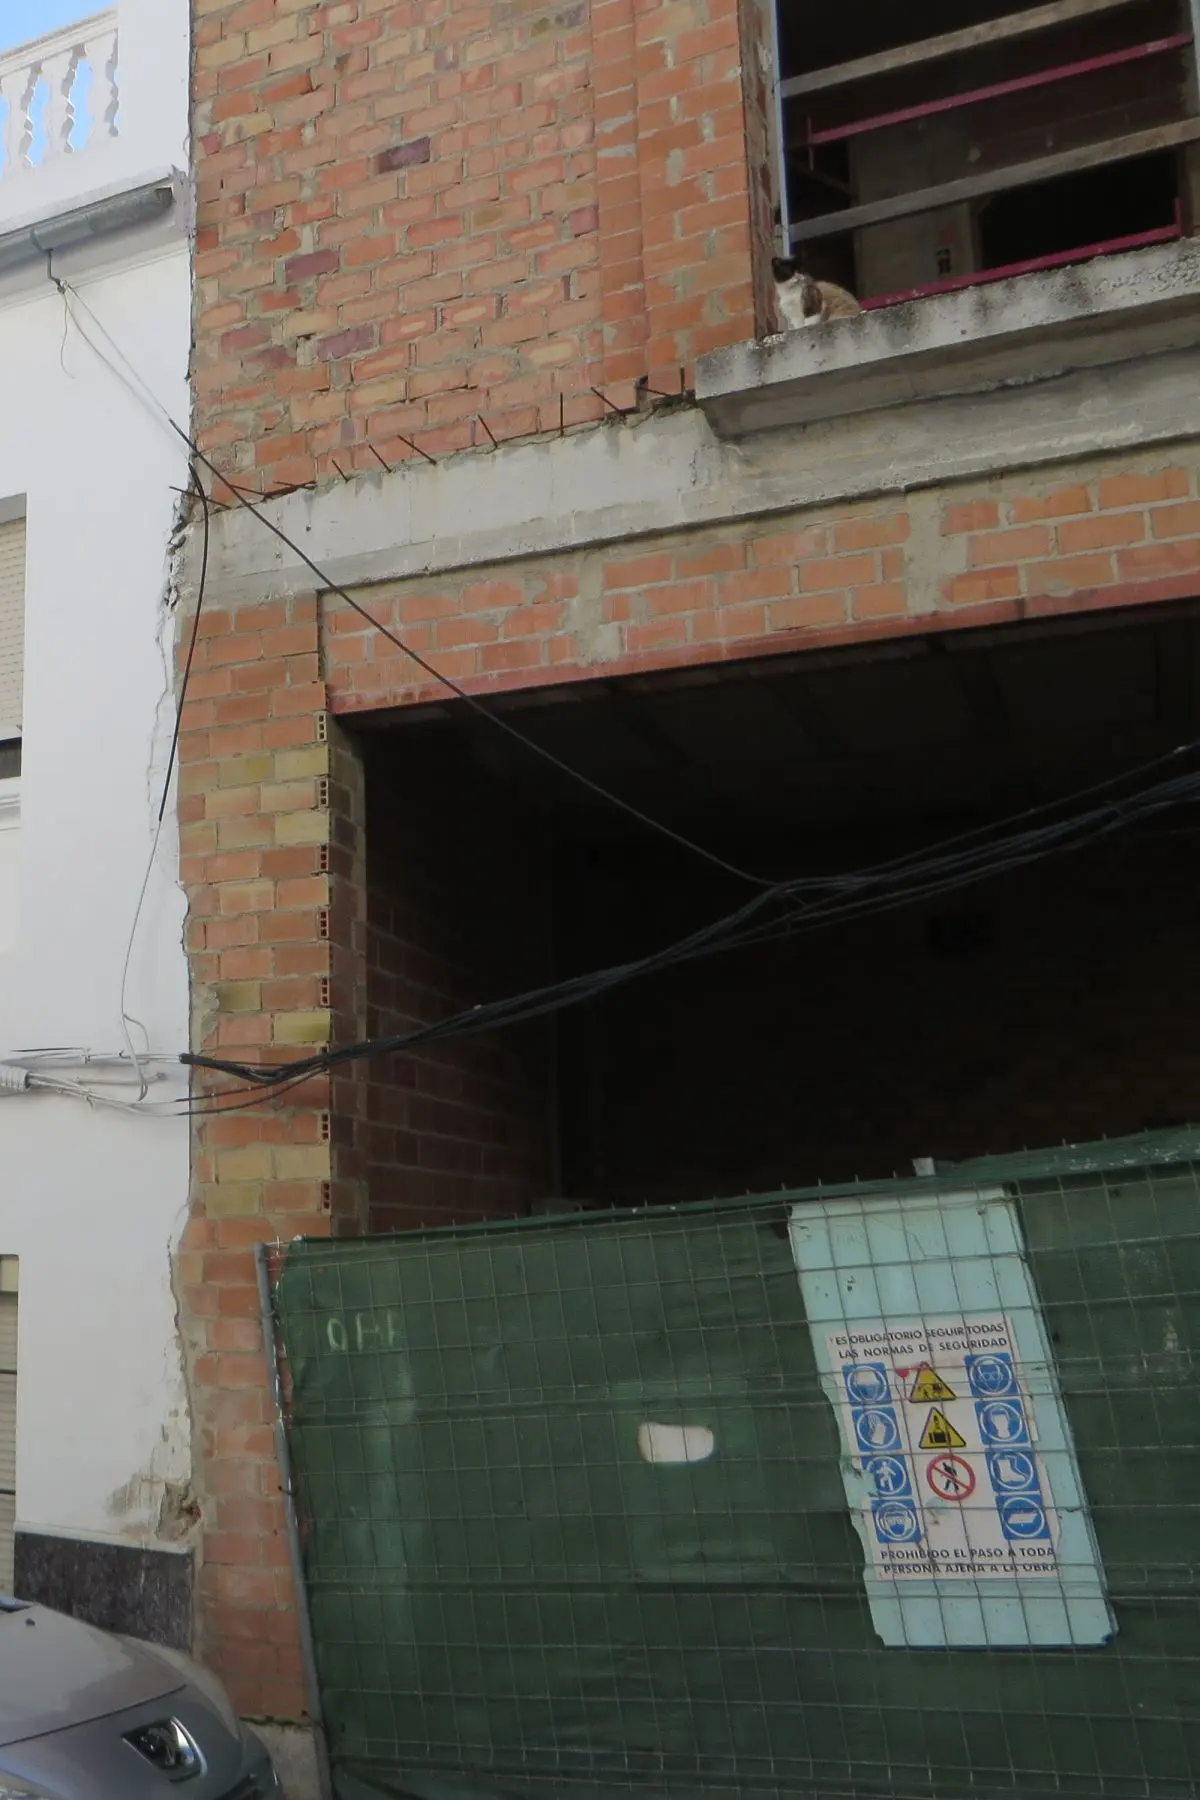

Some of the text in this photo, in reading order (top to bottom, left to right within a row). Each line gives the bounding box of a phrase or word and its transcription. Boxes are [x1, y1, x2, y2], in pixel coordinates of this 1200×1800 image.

[835, 1322, 1004, 1346] ES OBLIGATORIO SEGUIR TODAS
[838, 1336, 1008, 1359] LAS NORMAS DE SEGURIDAD
[880, 1547, 1056, 1560] PROHIBIDO EL PASO A TODA
[883, 1562, 1058, 1574] PERSONA AJENA A LA OBRA
